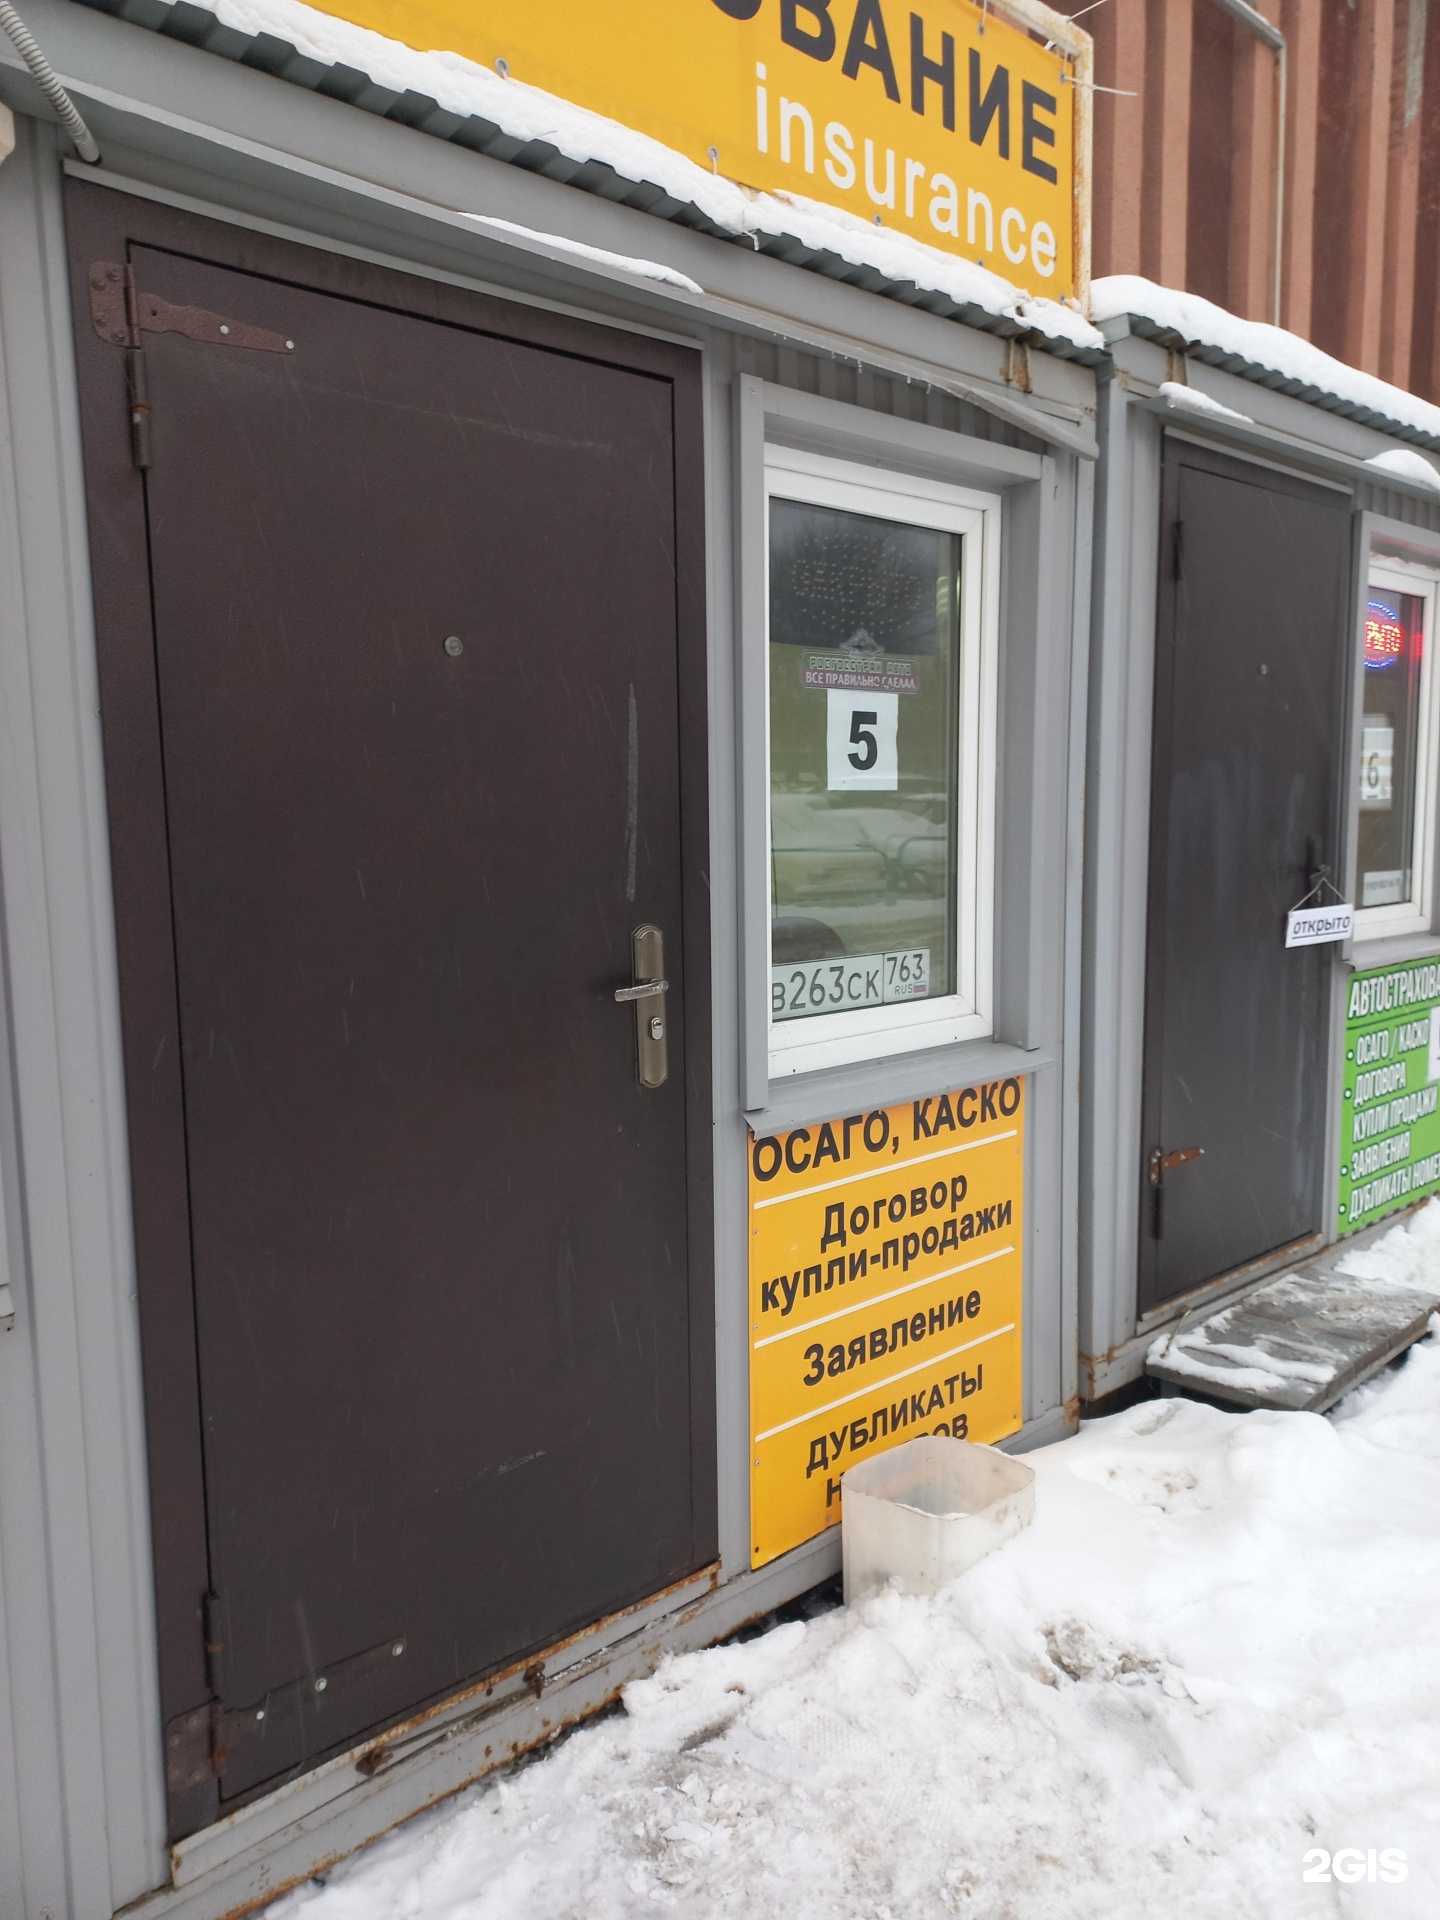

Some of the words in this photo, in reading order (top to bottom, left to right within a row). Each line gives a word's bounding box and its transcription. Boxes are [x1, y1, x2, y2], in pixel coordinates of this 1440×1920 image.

[711, 0, 1058, 185] ВАНИЕ
[756, 62, 1057, 279] insurance
[847, 710, 878, 771] 5
[886, 953, 924, 986] 763
[894, 983, 913, 995] RUS
[1356, 1029, 1390, 1066] ОСАГО
[1399, 1018, 1429, 1054] КАСКО
[1353, 1103, 1390, 1142] КУПЛИ
[1390, 1085, 1438, 1129] ПРОДАЖИ
[1354, 1060, 1406, 1108] ДОГОВОРА
[752, 1109, 899, 1182] ОСАГО,
[912, 1076, 1021, 1142] КАСКО
[820, 1174, 969, 1254] Договор
[1348, 1163, 1412, 1222] ДУБЛИКАТЫ
[760, 1199, 1013, 1317] купли-продажи
[803, 1289, 982, 1387] Заявление
[805, 1363, 983, 1479] ДУБЛИКАТЫ
